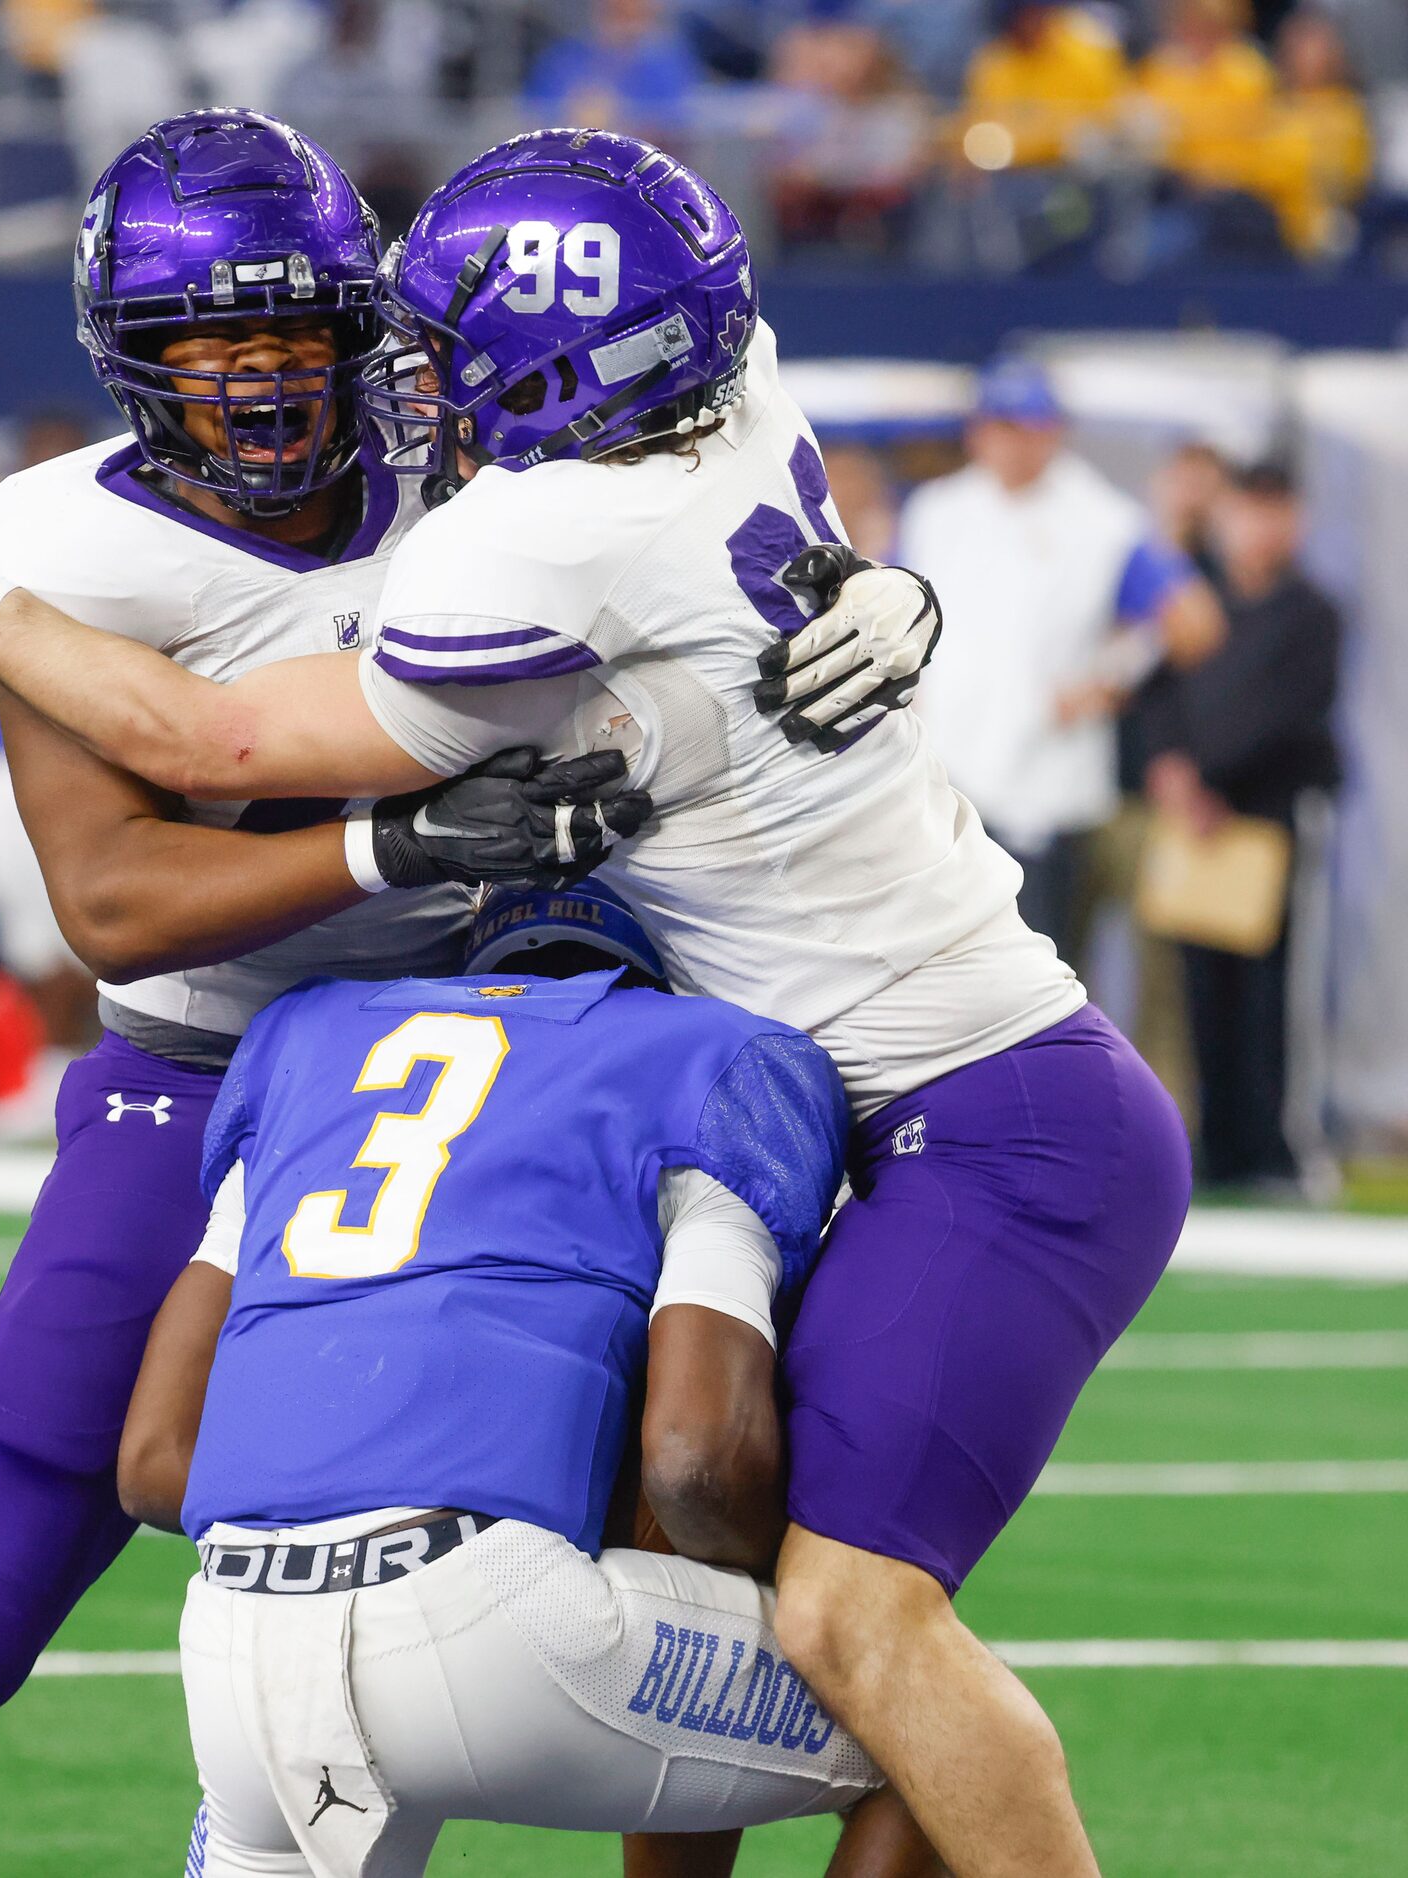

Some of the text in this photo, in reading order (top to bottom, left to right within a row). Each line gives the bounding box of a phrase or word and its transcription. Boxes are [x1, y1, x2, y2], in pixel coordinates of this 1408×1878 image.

[501, 220, 621, 317] 99
[547, 899, 605, 927] HILL
[280, 1011, 512, 1279] 3
[627, 1619, 835, 1755] BULLDOGS
